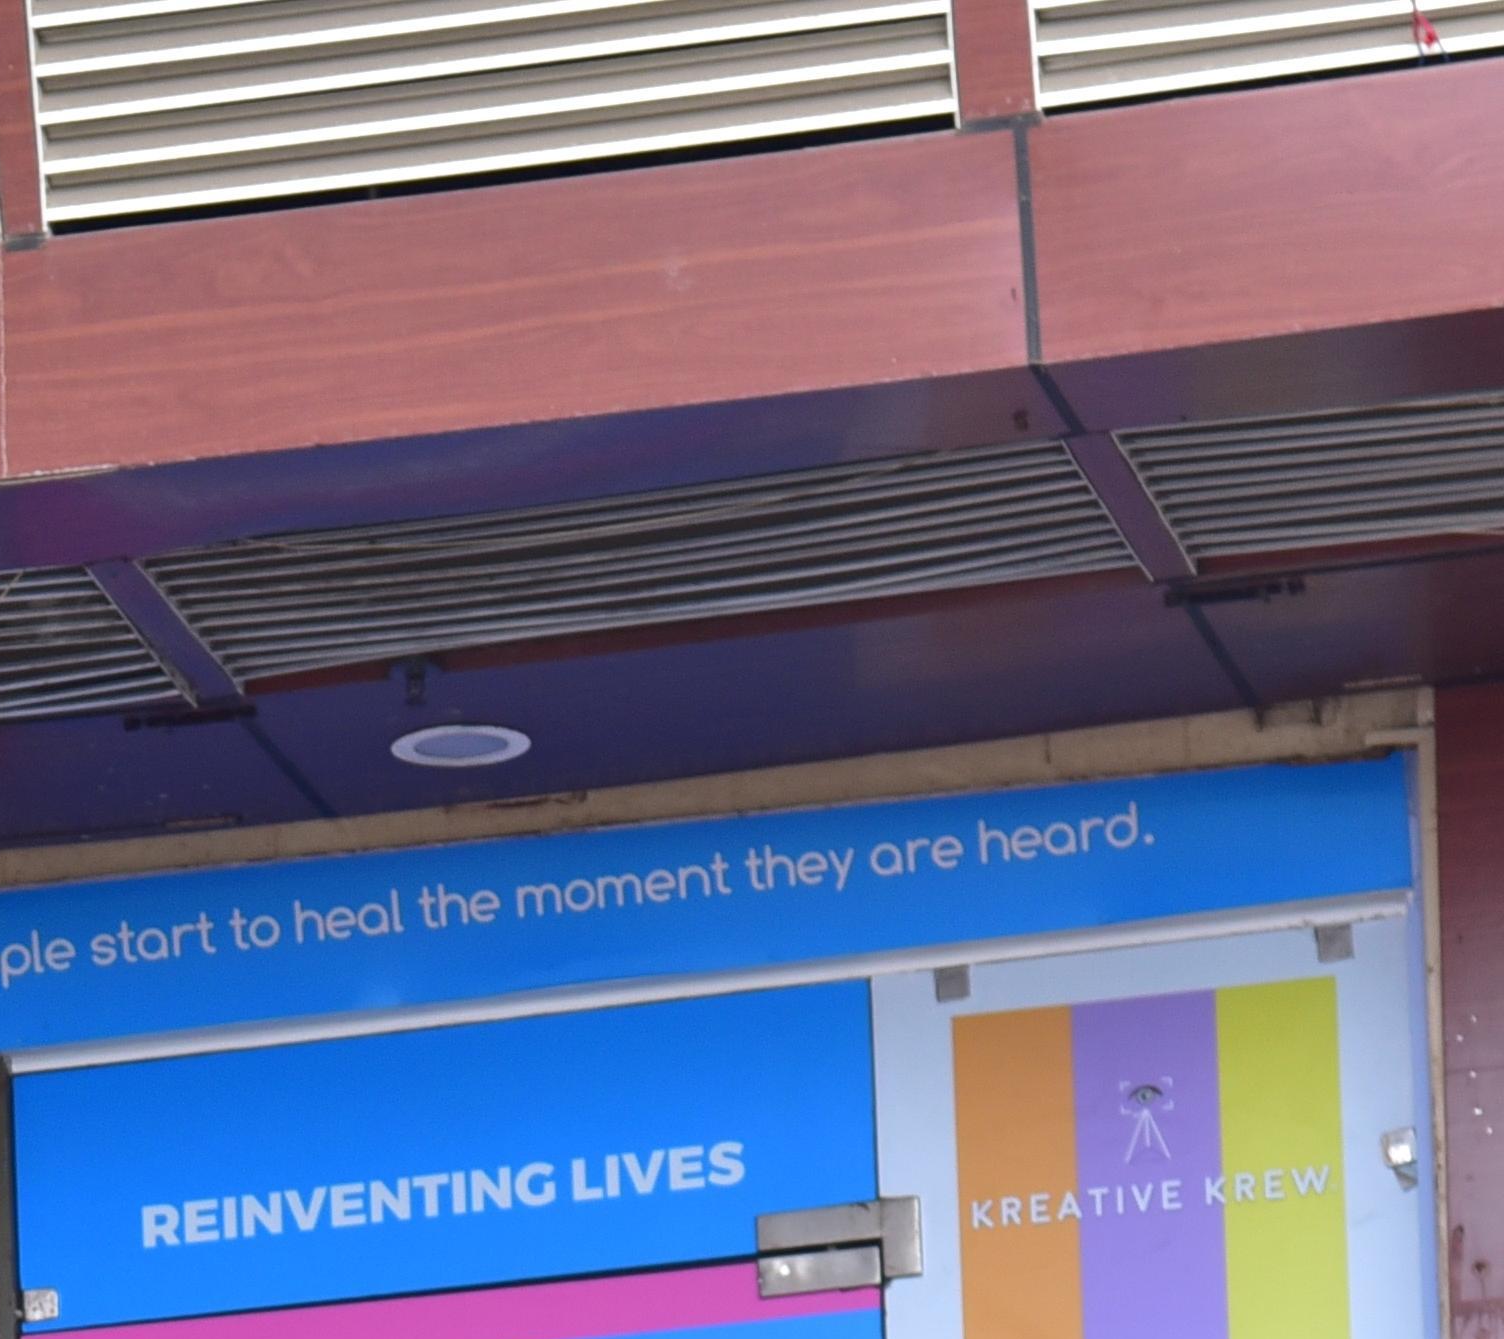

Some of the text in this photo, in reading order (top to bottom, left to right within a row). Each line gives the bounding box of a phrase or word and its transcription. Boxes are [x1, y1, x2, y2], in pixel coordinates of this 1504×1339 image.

[90, 911, 216, 967] start
[229, 908, 280, 951] to
[294, 889, 404, 944] heal
[418, 883, 500, 929] the
[516, 852, 732, 918] moment
[745, 844, 854, 892] they
[870, 836, 963, 876] are
[979, 802, 1154, 865] heard.
[142, 1141, 745, 1249] REINVENTING LIVES
[970, 1165, 1331, 1229] KREATIVE KREW
